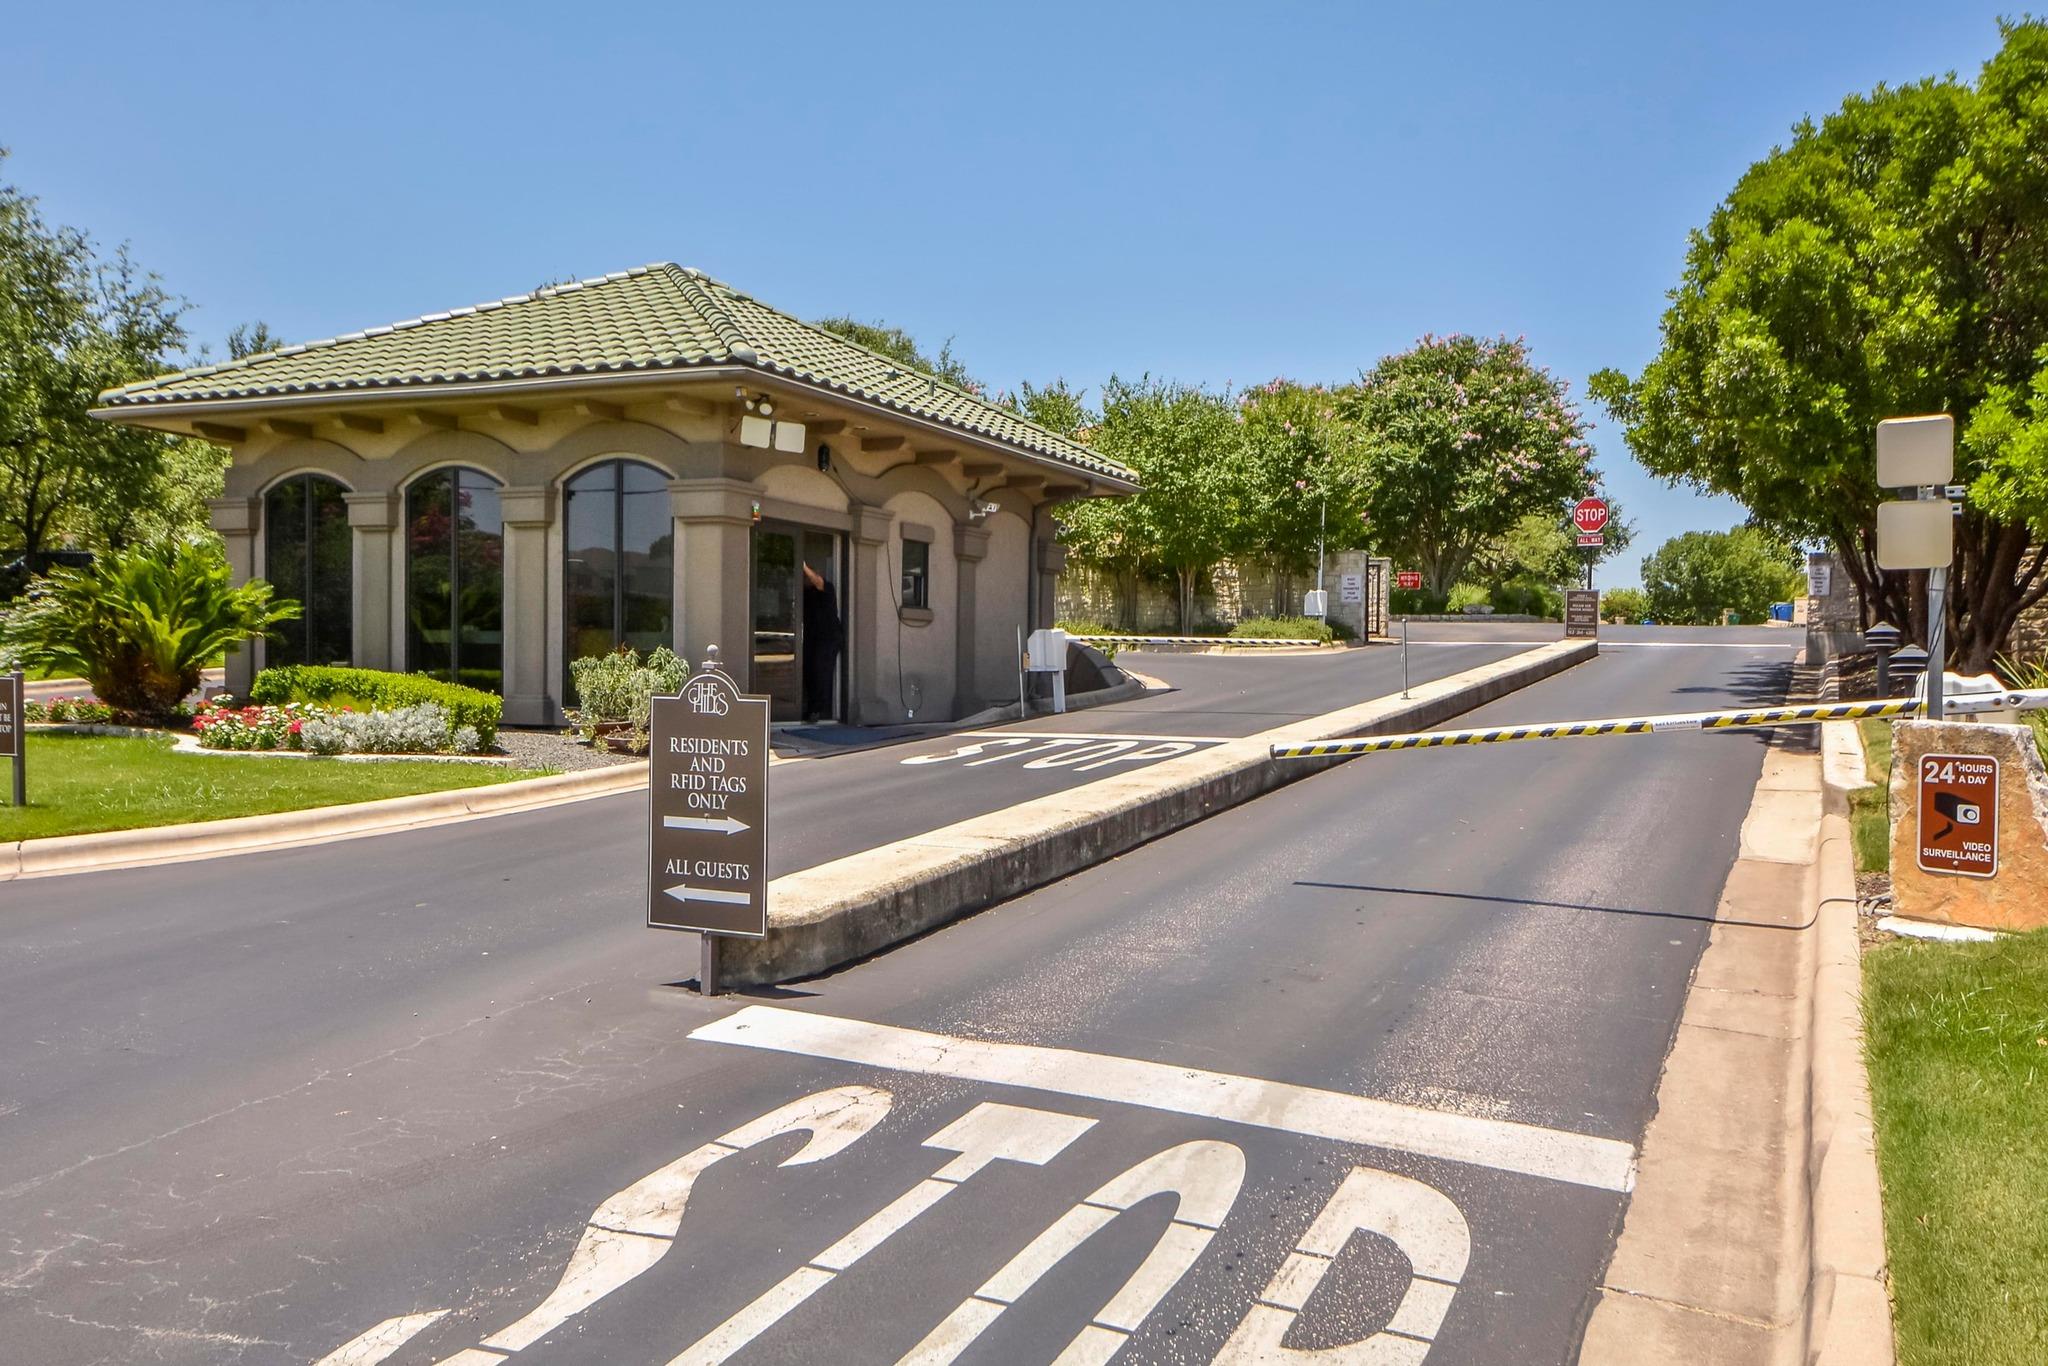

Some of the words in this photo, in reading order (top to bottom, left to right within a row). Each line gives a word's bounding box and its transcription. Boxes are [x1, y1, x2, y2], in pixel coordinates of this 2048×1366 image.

[1576, 508, 1605, 521] STOP
[688, 682, 718, 704] THE
[669, 736, 749, 757] RESIDENTS
[900, 738, 1197, 772] STOP
[689, 756, 726, 773] AND
[1924, 761, 1955, 784] 24
[1958, 764, 1993, 774] HOURS
[670, 773, 706, 791] RFID
[708, 775, 747, 794] TAGS
[1958, 775, 1966, 784] A
[1967, 775, 1988, 785] DAY
[687, 792, 729, 810] ONLY
[1923, 848, 1991, 862] SURVEILLANCE
[1962, 841, 1991, 852] VIDEO
[665, 858, 691, 876] ALL
[694, 861, 750, 881] GUESTS
[311, 1084, 1472, 1366] STOP
